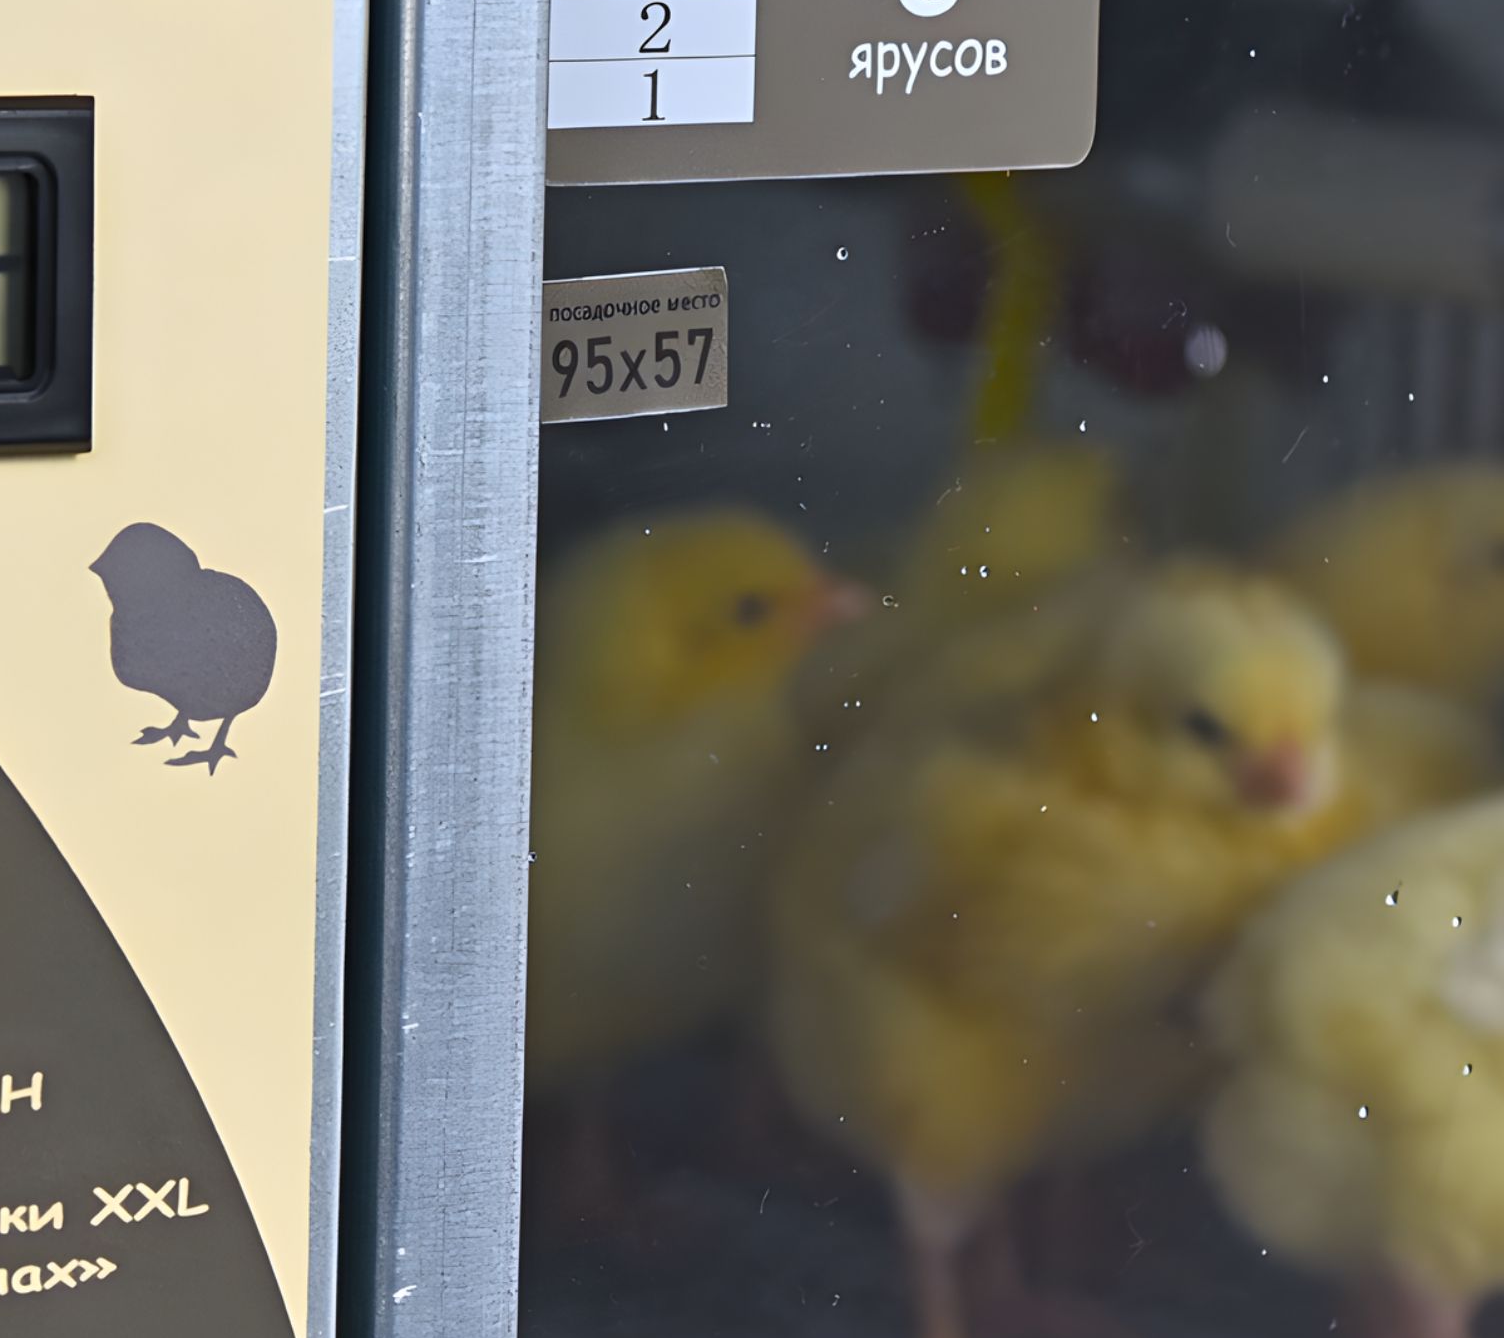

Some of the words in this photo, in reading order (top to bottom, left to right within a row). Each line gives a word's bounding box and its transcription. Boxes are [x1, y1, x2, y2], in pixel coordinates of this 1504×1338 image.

[638, 1, 672, 54] 2
[849, 36, 1008, 95] ярусов
[641, 70, 665, 122] 1
[549, 298, 660, 322] посадочное
[91, 1178, 209, 1228] XXL
